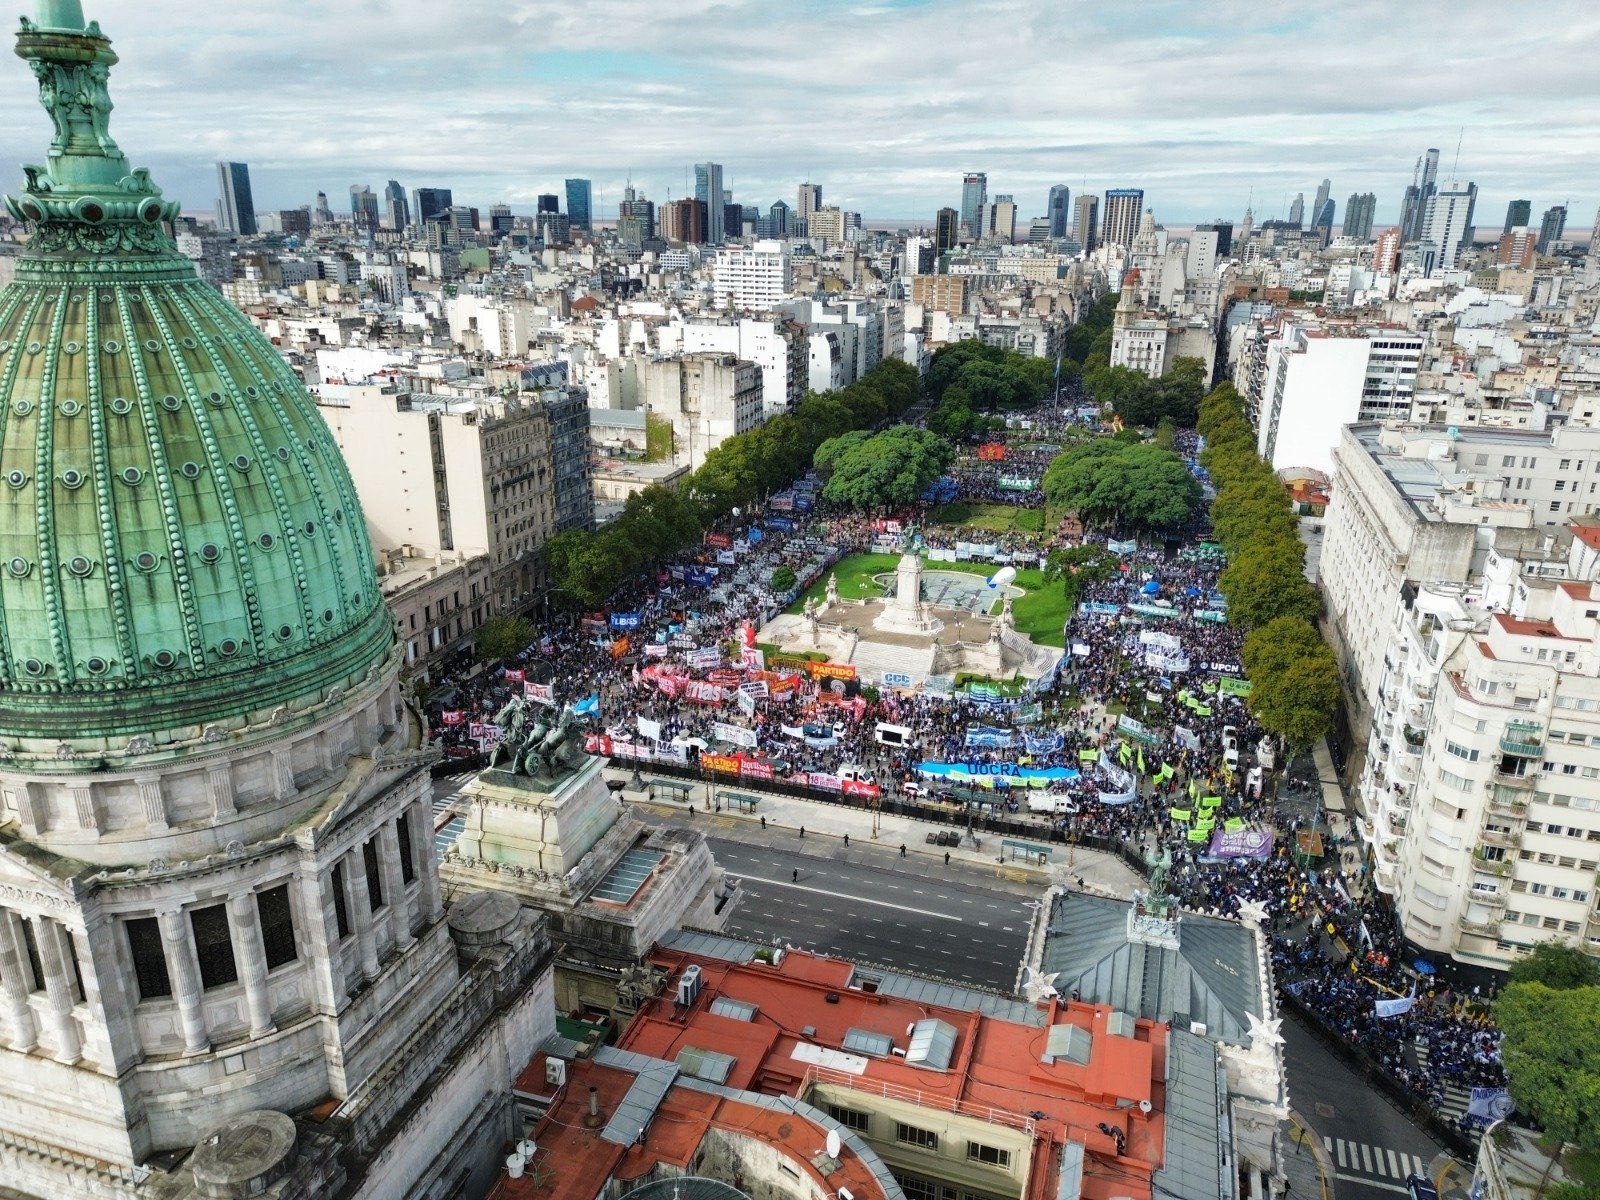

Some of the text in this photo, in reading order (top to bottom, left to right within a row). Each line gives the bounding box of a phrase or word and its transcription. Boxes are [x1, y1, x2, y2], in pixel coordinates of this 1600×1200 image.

[813, 664, 854, 677] PARTIDO
[1211, 662, 1239, 672] UPCN
[884, 673, 910, 683] CCC
[702, 755, 739, 768] PARTIDO
[967, 762, 1022, 778] UOCRA
